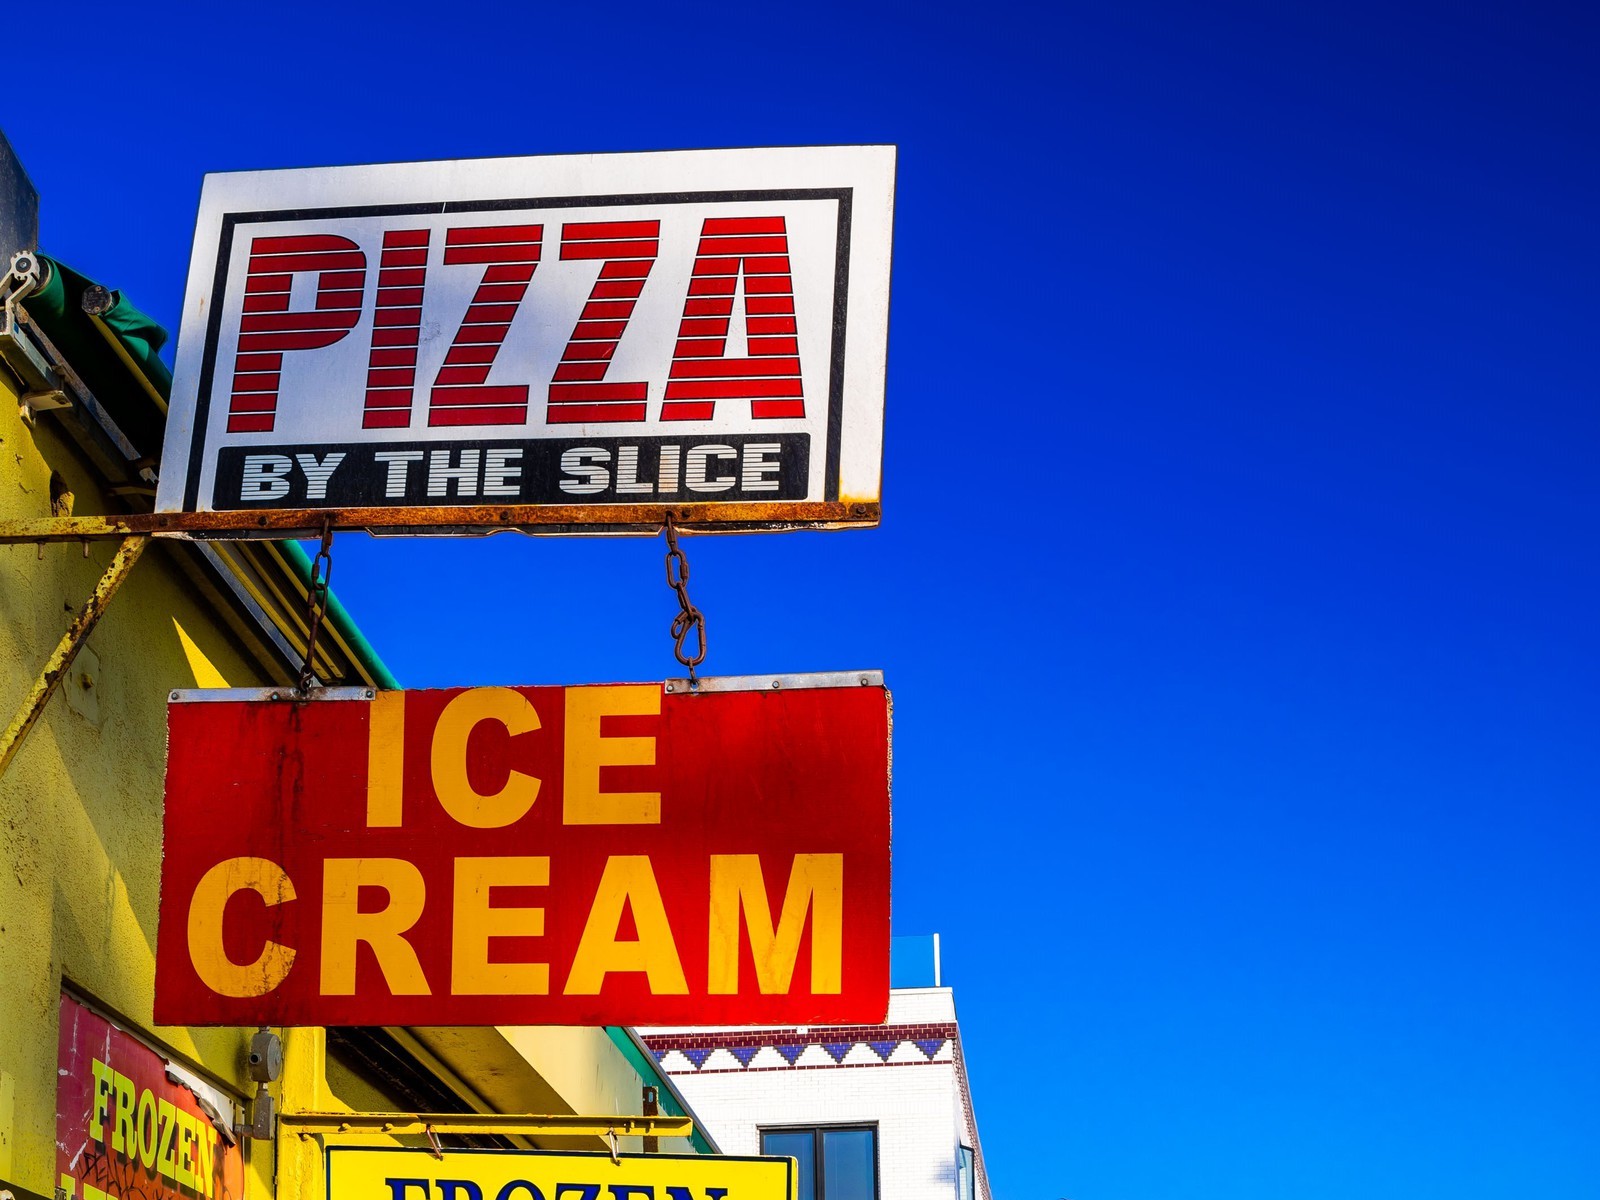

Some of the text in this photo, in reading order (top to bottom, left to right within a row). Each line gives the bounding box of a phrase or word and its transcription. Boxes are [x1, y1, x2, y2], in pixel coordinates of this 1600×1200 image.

[227, 216, 806, 434] PIZZA
[240, 443, 781, 501] BY THE SLICE
[366, 684, 662, 829] ICE
[187, 853, 844, 999] CREAM
[89, 1058, 218, 1199] FROZEN
